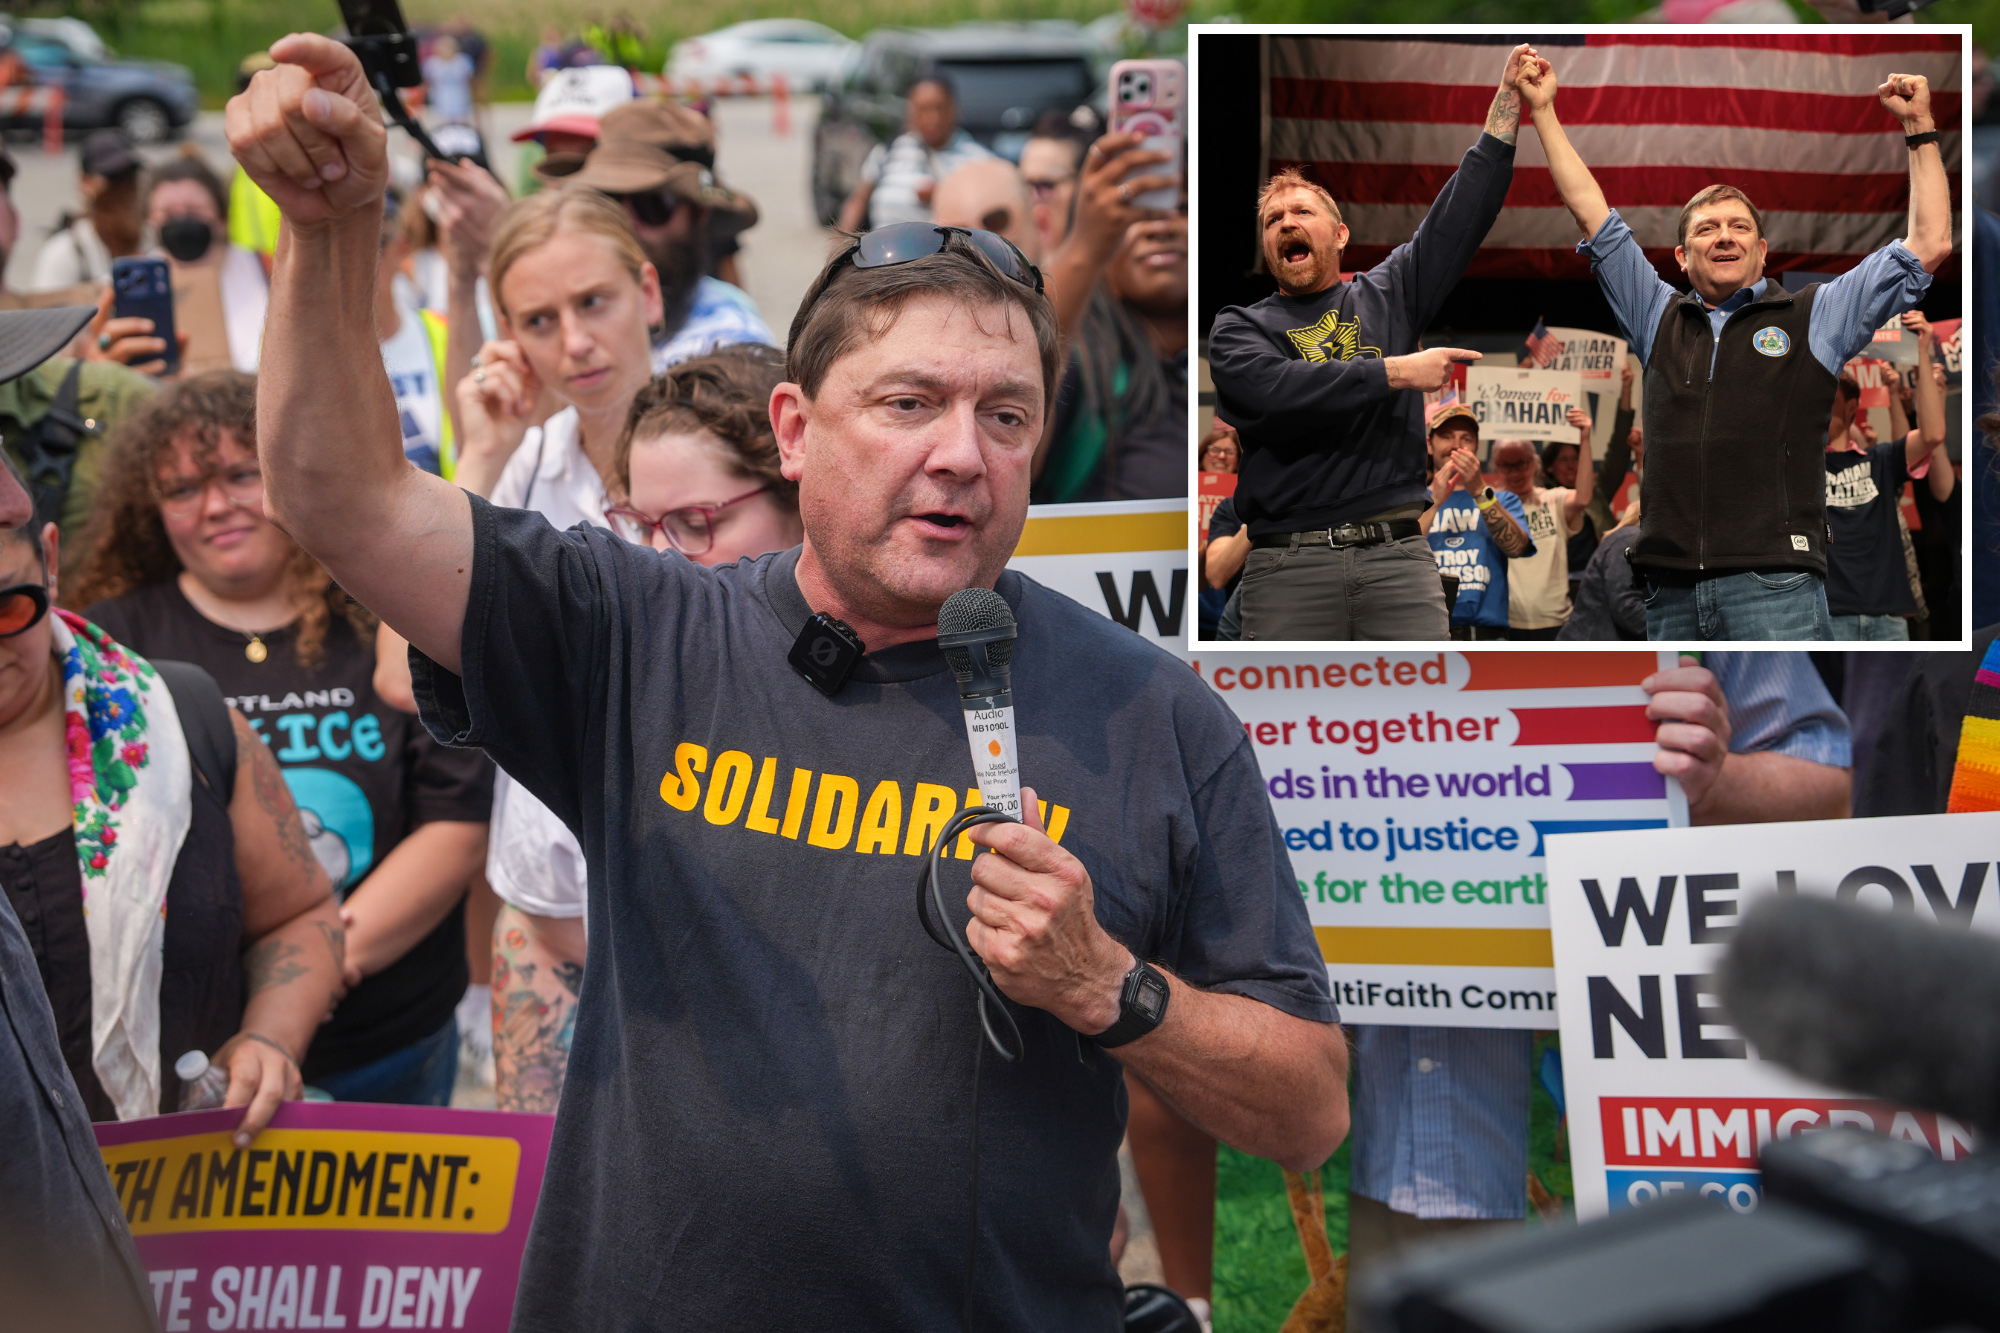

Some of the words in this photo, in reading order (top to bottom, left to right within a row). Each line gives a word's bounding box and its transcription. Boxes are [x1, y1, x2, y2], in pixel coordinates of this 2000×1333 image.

[1561, 340, 1615, 354] AHAM
[1546, 387, 1571, 402] for
[1826, 477, 1876, 498] LATNER
[1214, 652, 1447, 690] connected
[974, 709, 1004, 721] Audio
[1307, 710, 1500, 755] together
[276, 710, 386, 762] ICE
[1265, 768, 1316, 799] ds
[1321, 765, 1357, 799] in
[1363, 767, 1430, 799] the
[1435, 764, 1551, 798] world
[660, 742, 1071, 861] SOLIDARIY
[1280, 820, 1332, 851] ed
[1339, 822, 1379, 851] to
[1385, 817, 1519, 862] justice
[1314, 871, 1367, 903] for
[1380, 873, 1445, 904] the
[169, 1149, 480, 1221] AMENDMENT:
[207, 1265, 347, 1332] SHALL
[358, 1265, 482, 1329] DENY
